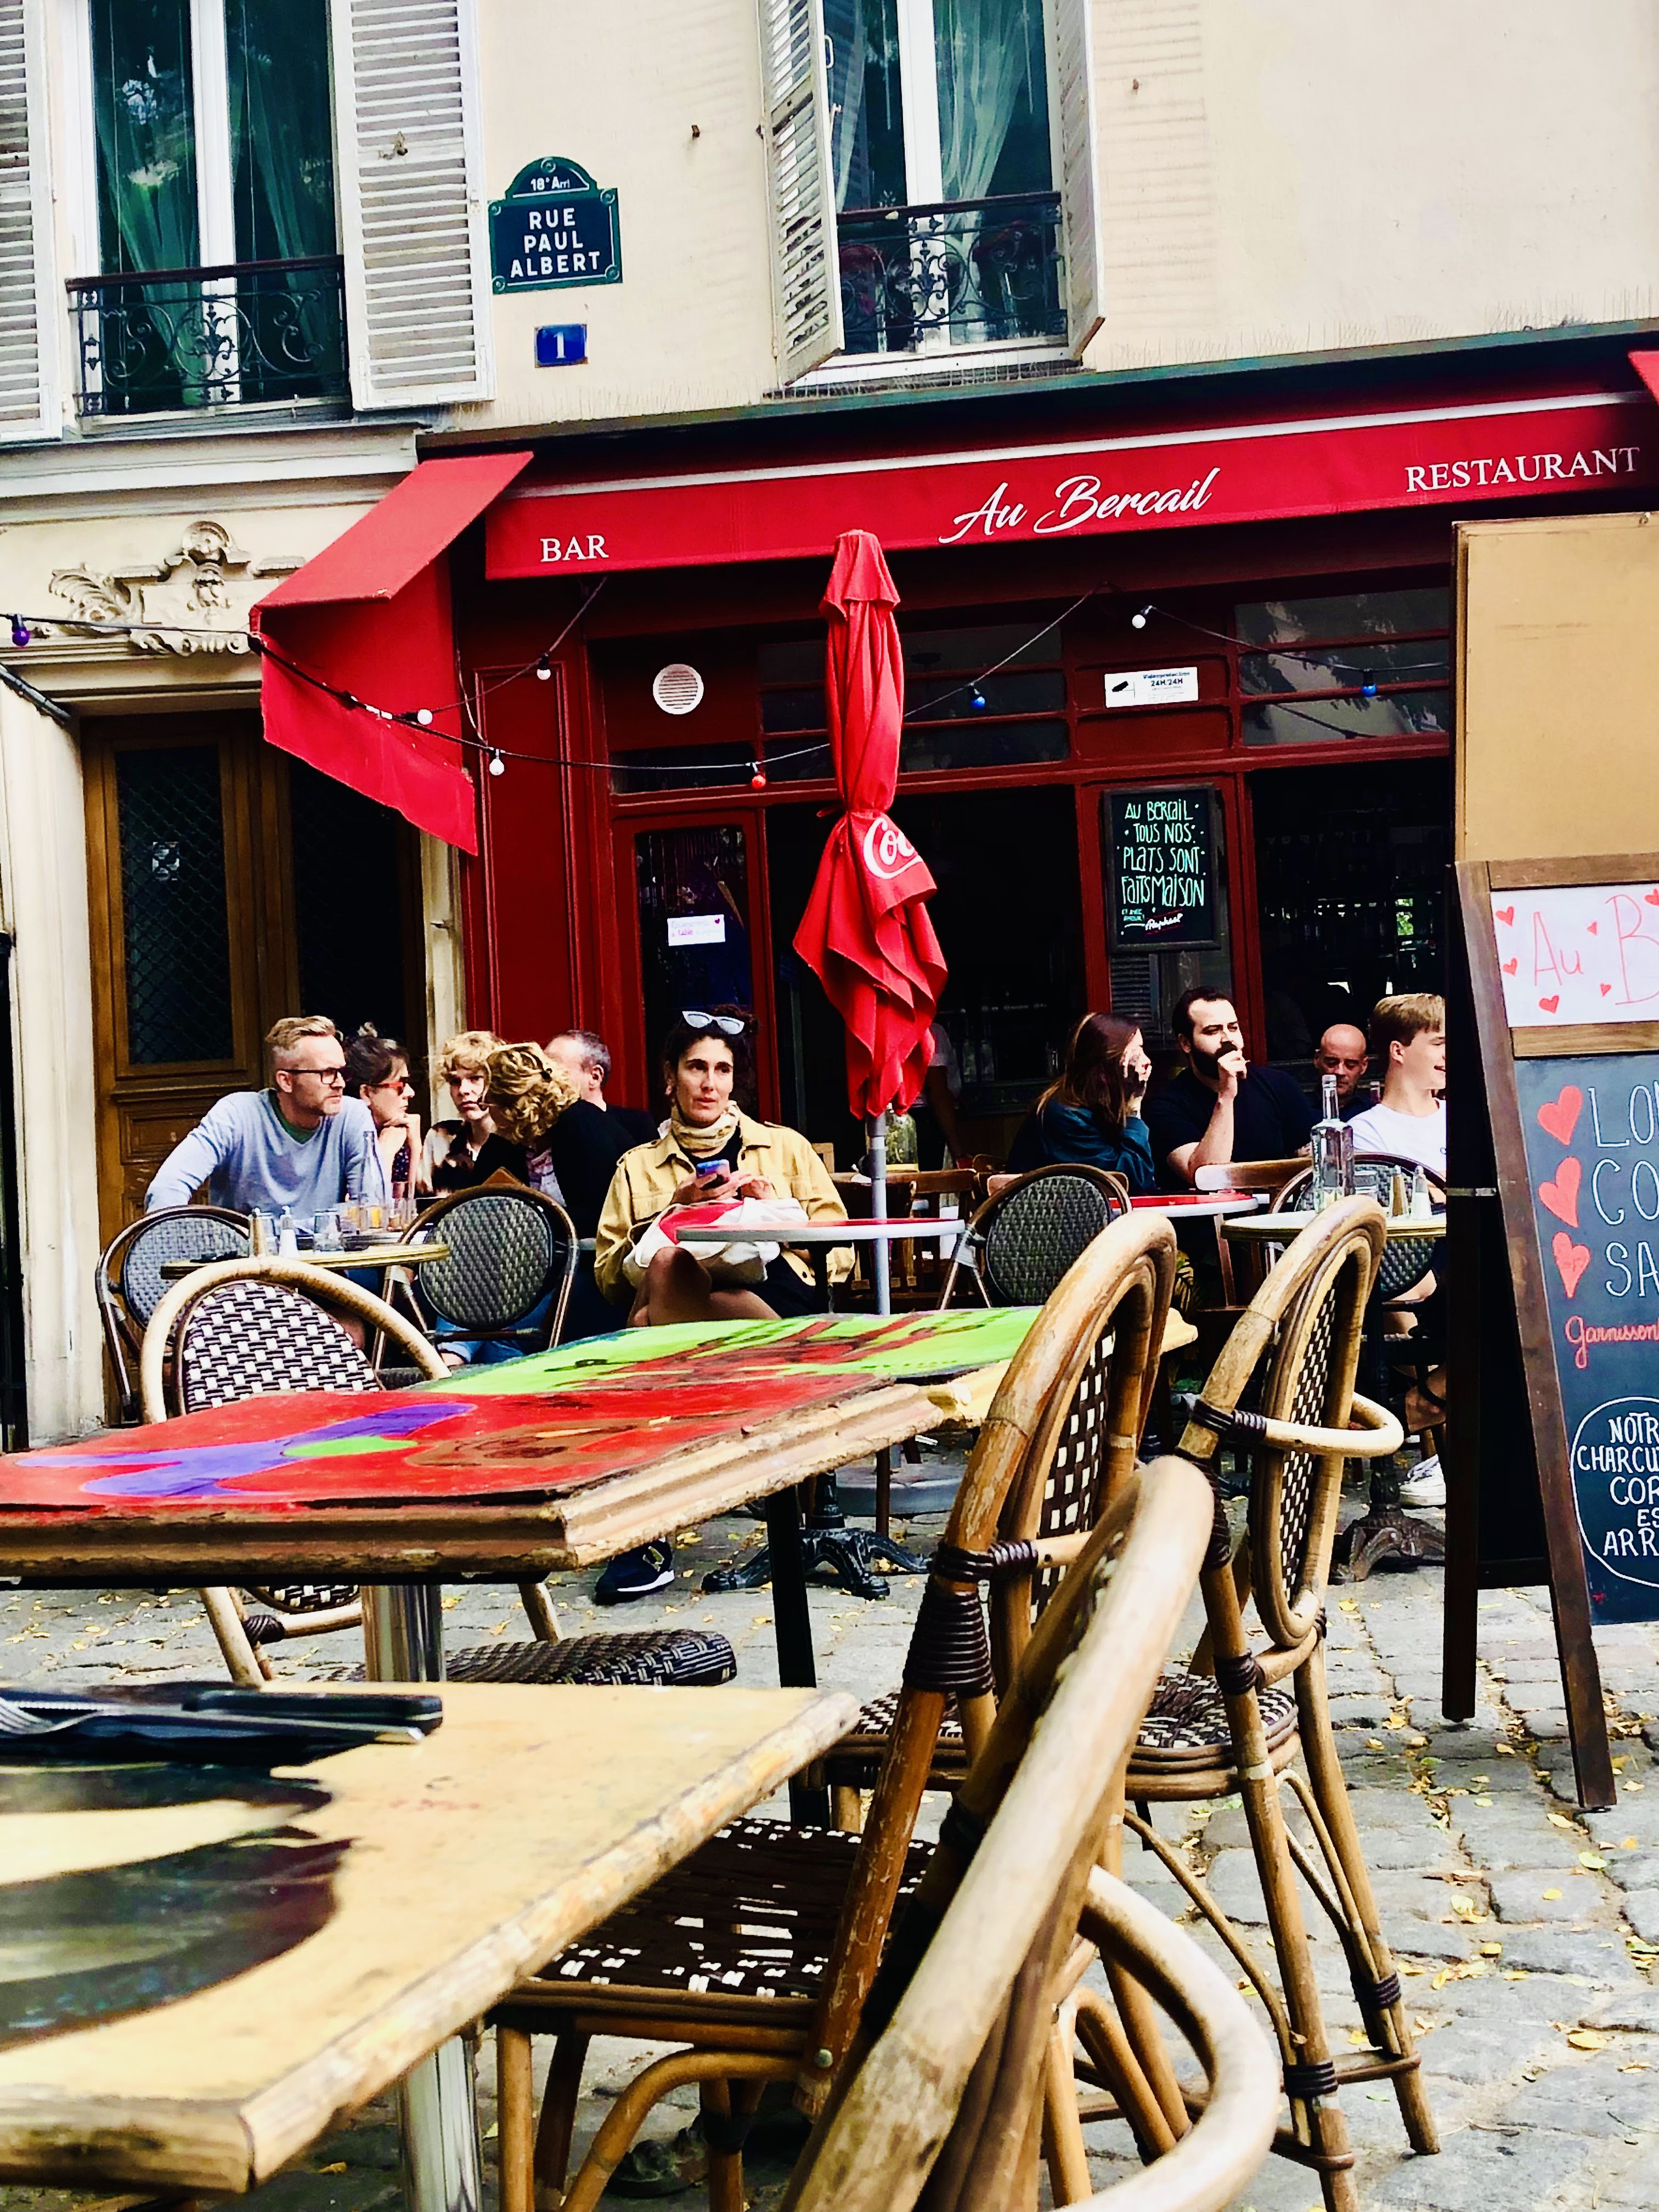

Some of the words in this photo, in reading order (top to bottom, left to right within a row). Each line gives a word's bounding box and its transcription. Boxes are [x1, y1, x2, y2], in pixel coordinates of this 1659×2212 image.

[529, 207, 576, 230] RUE
[524, 230, 584, 253] PAUL
[510, 251, 601, 278] ALBERT
[553, 331, 566, 359] 1
[1404, 447, 1640, 493] RESTAURANT
[938, 482, 1028, 544] Au
[1033, 467, 1221, 533] Bercail
[540, 534, 610, 562] BAR
[1125, 803, 1141, 819] AU
[1133, 822, 1160, 843] TOUS
[1169, 847, 1200, 874] SONT
[1533, 911, 1584, 986] Au
[1587, 1080, 1659, 1147] LO
[1605, 1241, 1659, 1297] SA
[1577, 1444, 1659, 1474] CHARCU
